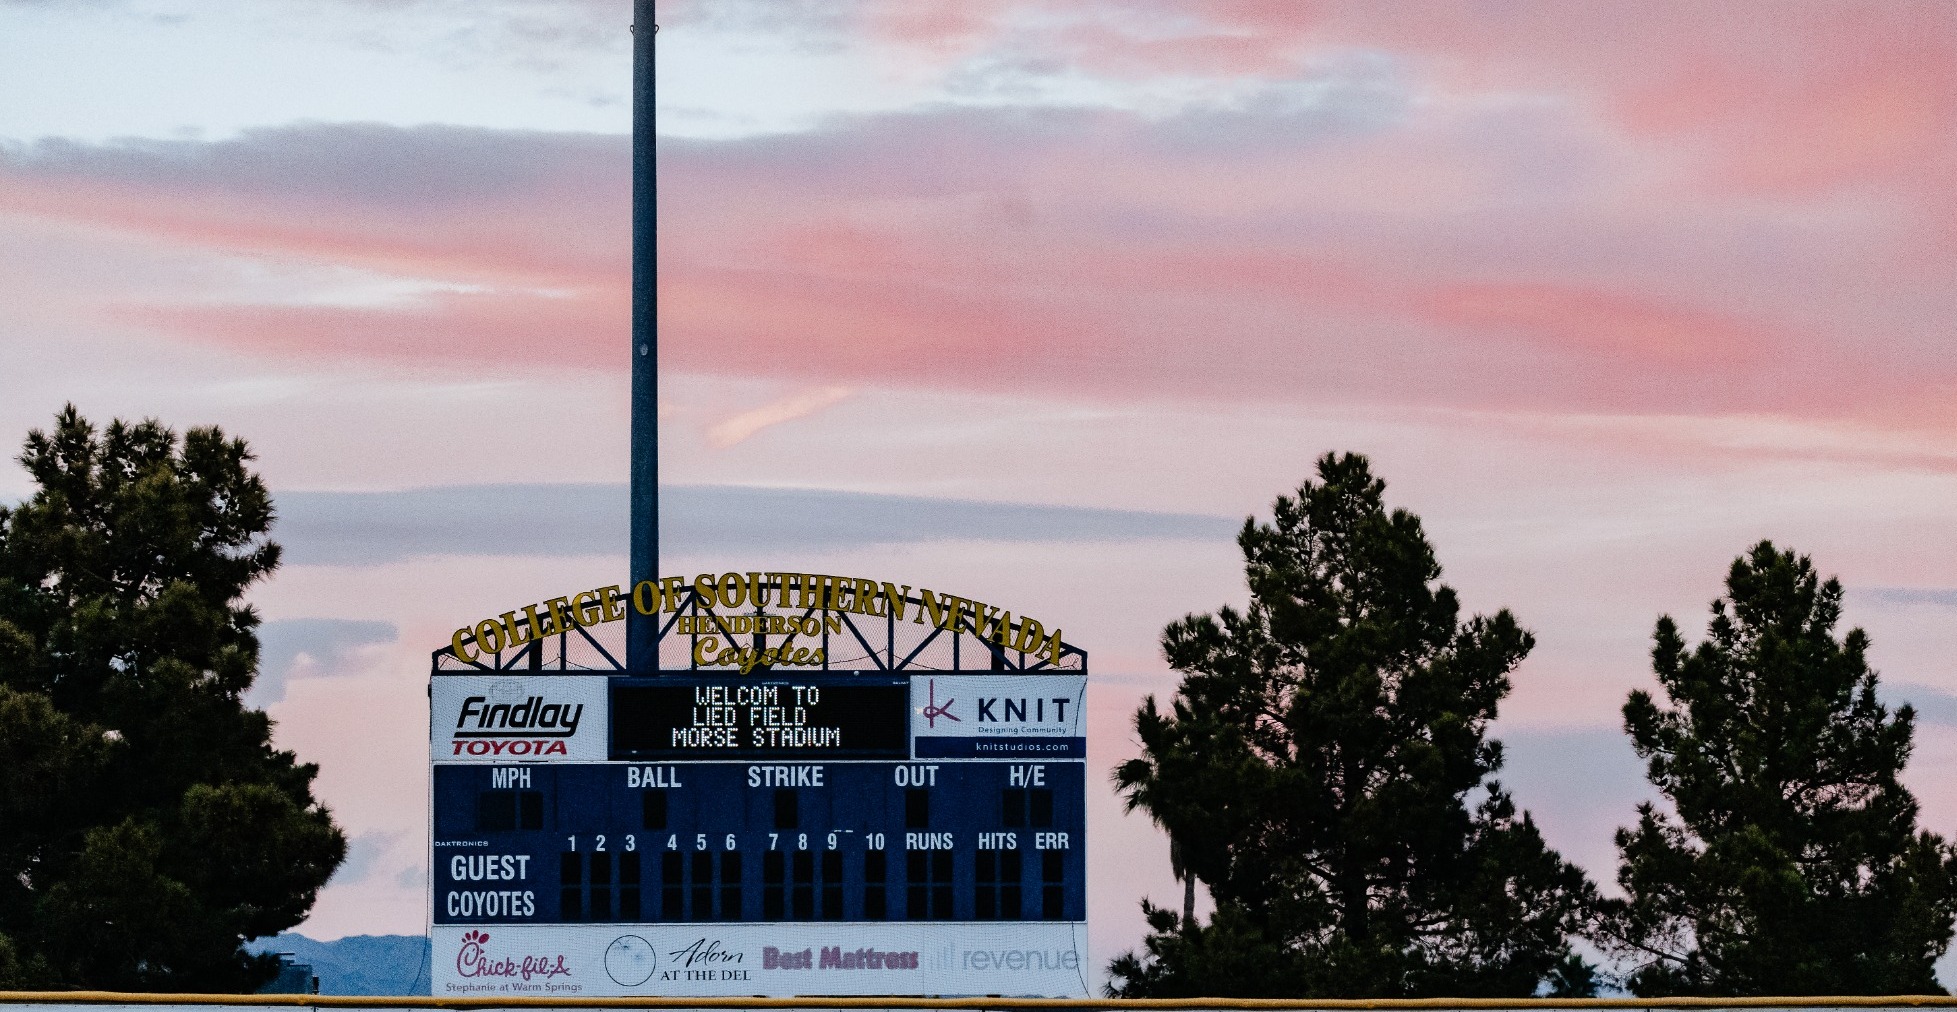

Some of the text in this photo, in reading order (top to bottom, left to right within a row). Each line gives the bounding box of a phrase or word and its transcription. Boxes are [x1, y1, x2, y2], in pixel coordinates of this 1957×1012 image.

[452, 572, 1062, 666] COLLEGE OF SOUTHERN NEVADA
[677, 615, 841, 637] HENDERSON
[694, 636, 825, 675] Coyotes
[695, 686, 819, 705] WELCOM TO
[454, 697, 583, 737] Findlay
[693, 707, 806, 726] LIED FIELD
[978, 698, 1070, 722] KNIT
[452, 740, 567, 755] TOYOTA
[672, 727, 840, 747] MORSE STADIUM
[976, 742, 1069, 751] knitstudios.com
[492, 765, 1045, 788] MPH BALL STRIKE OUT H/E
[568, 833, 1069, 851] 1 2 3 4 5 6 7 8 9 10 RUNS HITS ERR
[451, 855, 530, 880] GUEST
[447, 891, 535, 916] COYOTES
[457, 942, 572, 981] Chick-fil-A
[669, 938, 743, 968] Adorn
[963, 950, 1081, 971] revenue
[661, 970, 751, 980] AT THE DEL
[446, 983, 582, 993] Stephanie at Warm Springs
